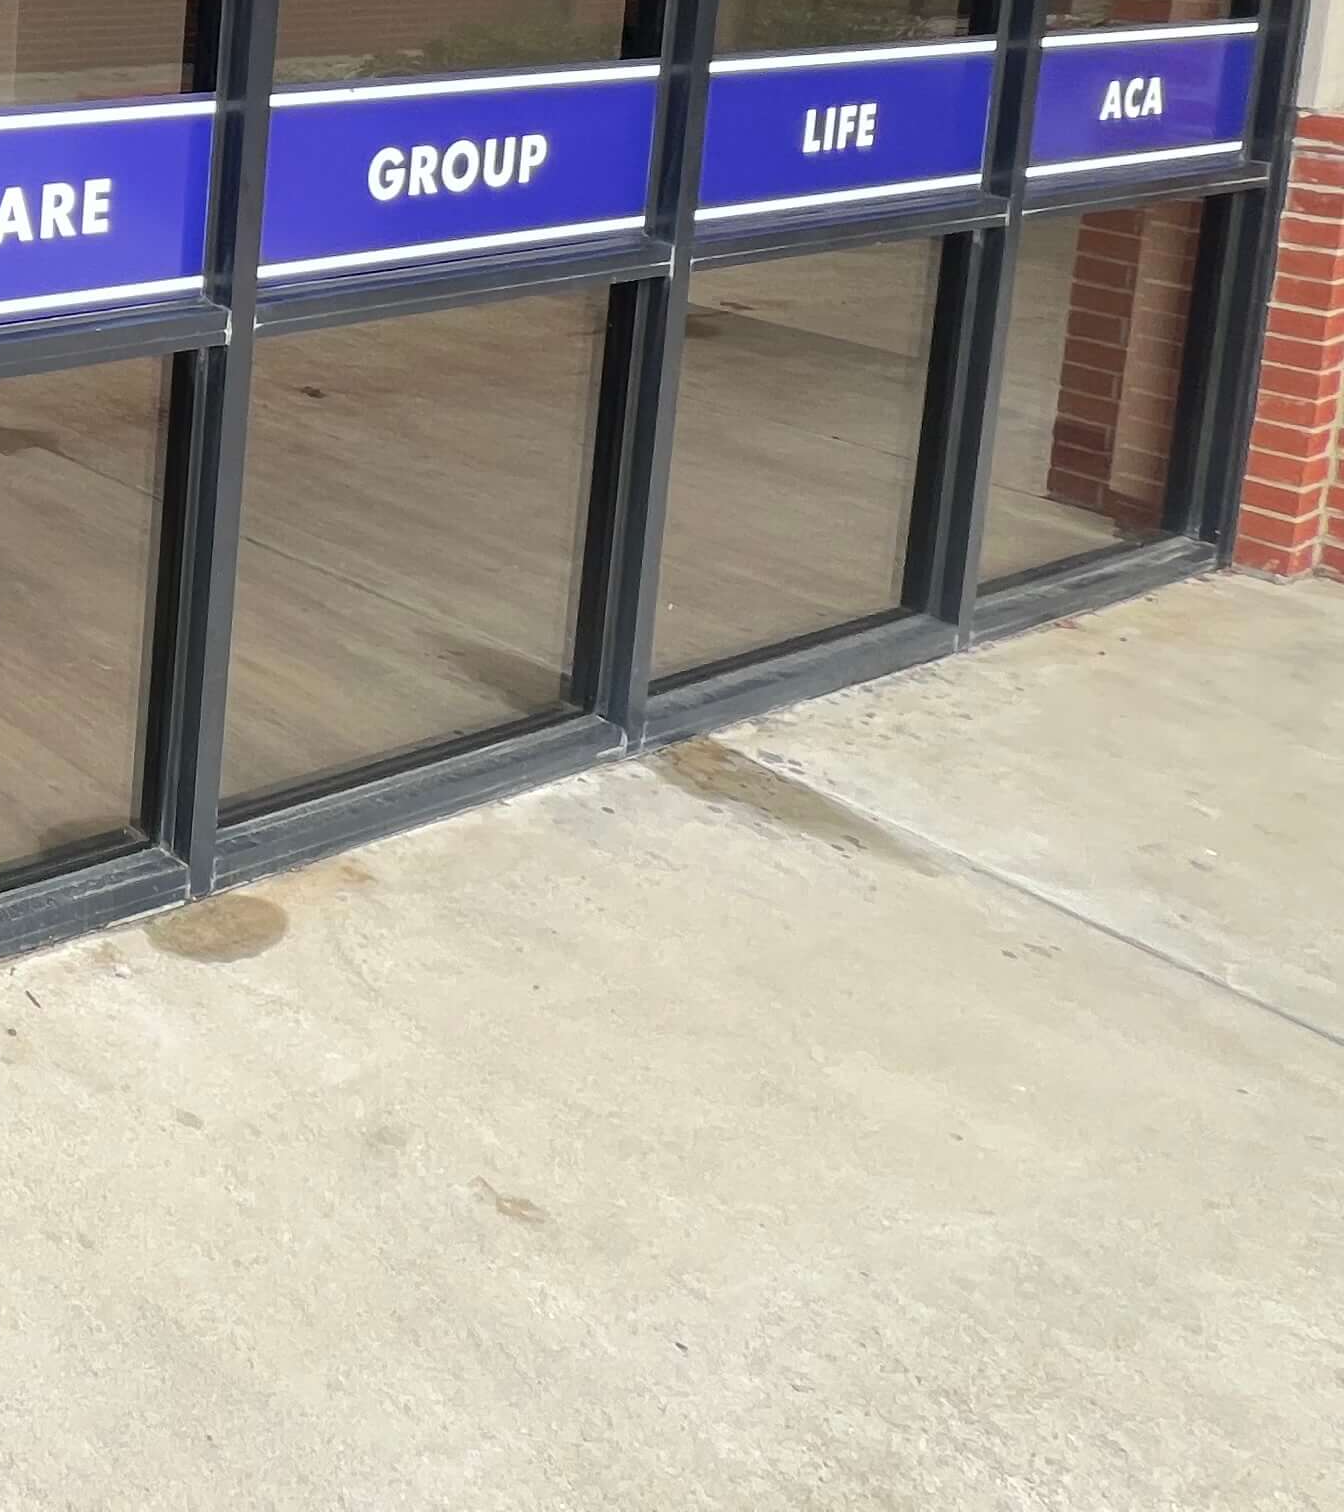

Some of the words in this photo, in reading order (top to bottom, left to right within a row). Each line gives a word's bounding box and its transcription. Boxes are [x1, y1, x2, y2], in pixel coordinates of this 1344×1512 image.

[1098, 76, 1164, 121] ACA
[802, 102, 878, 154] LIFE
[367, 134, 549, 202] GROUP
